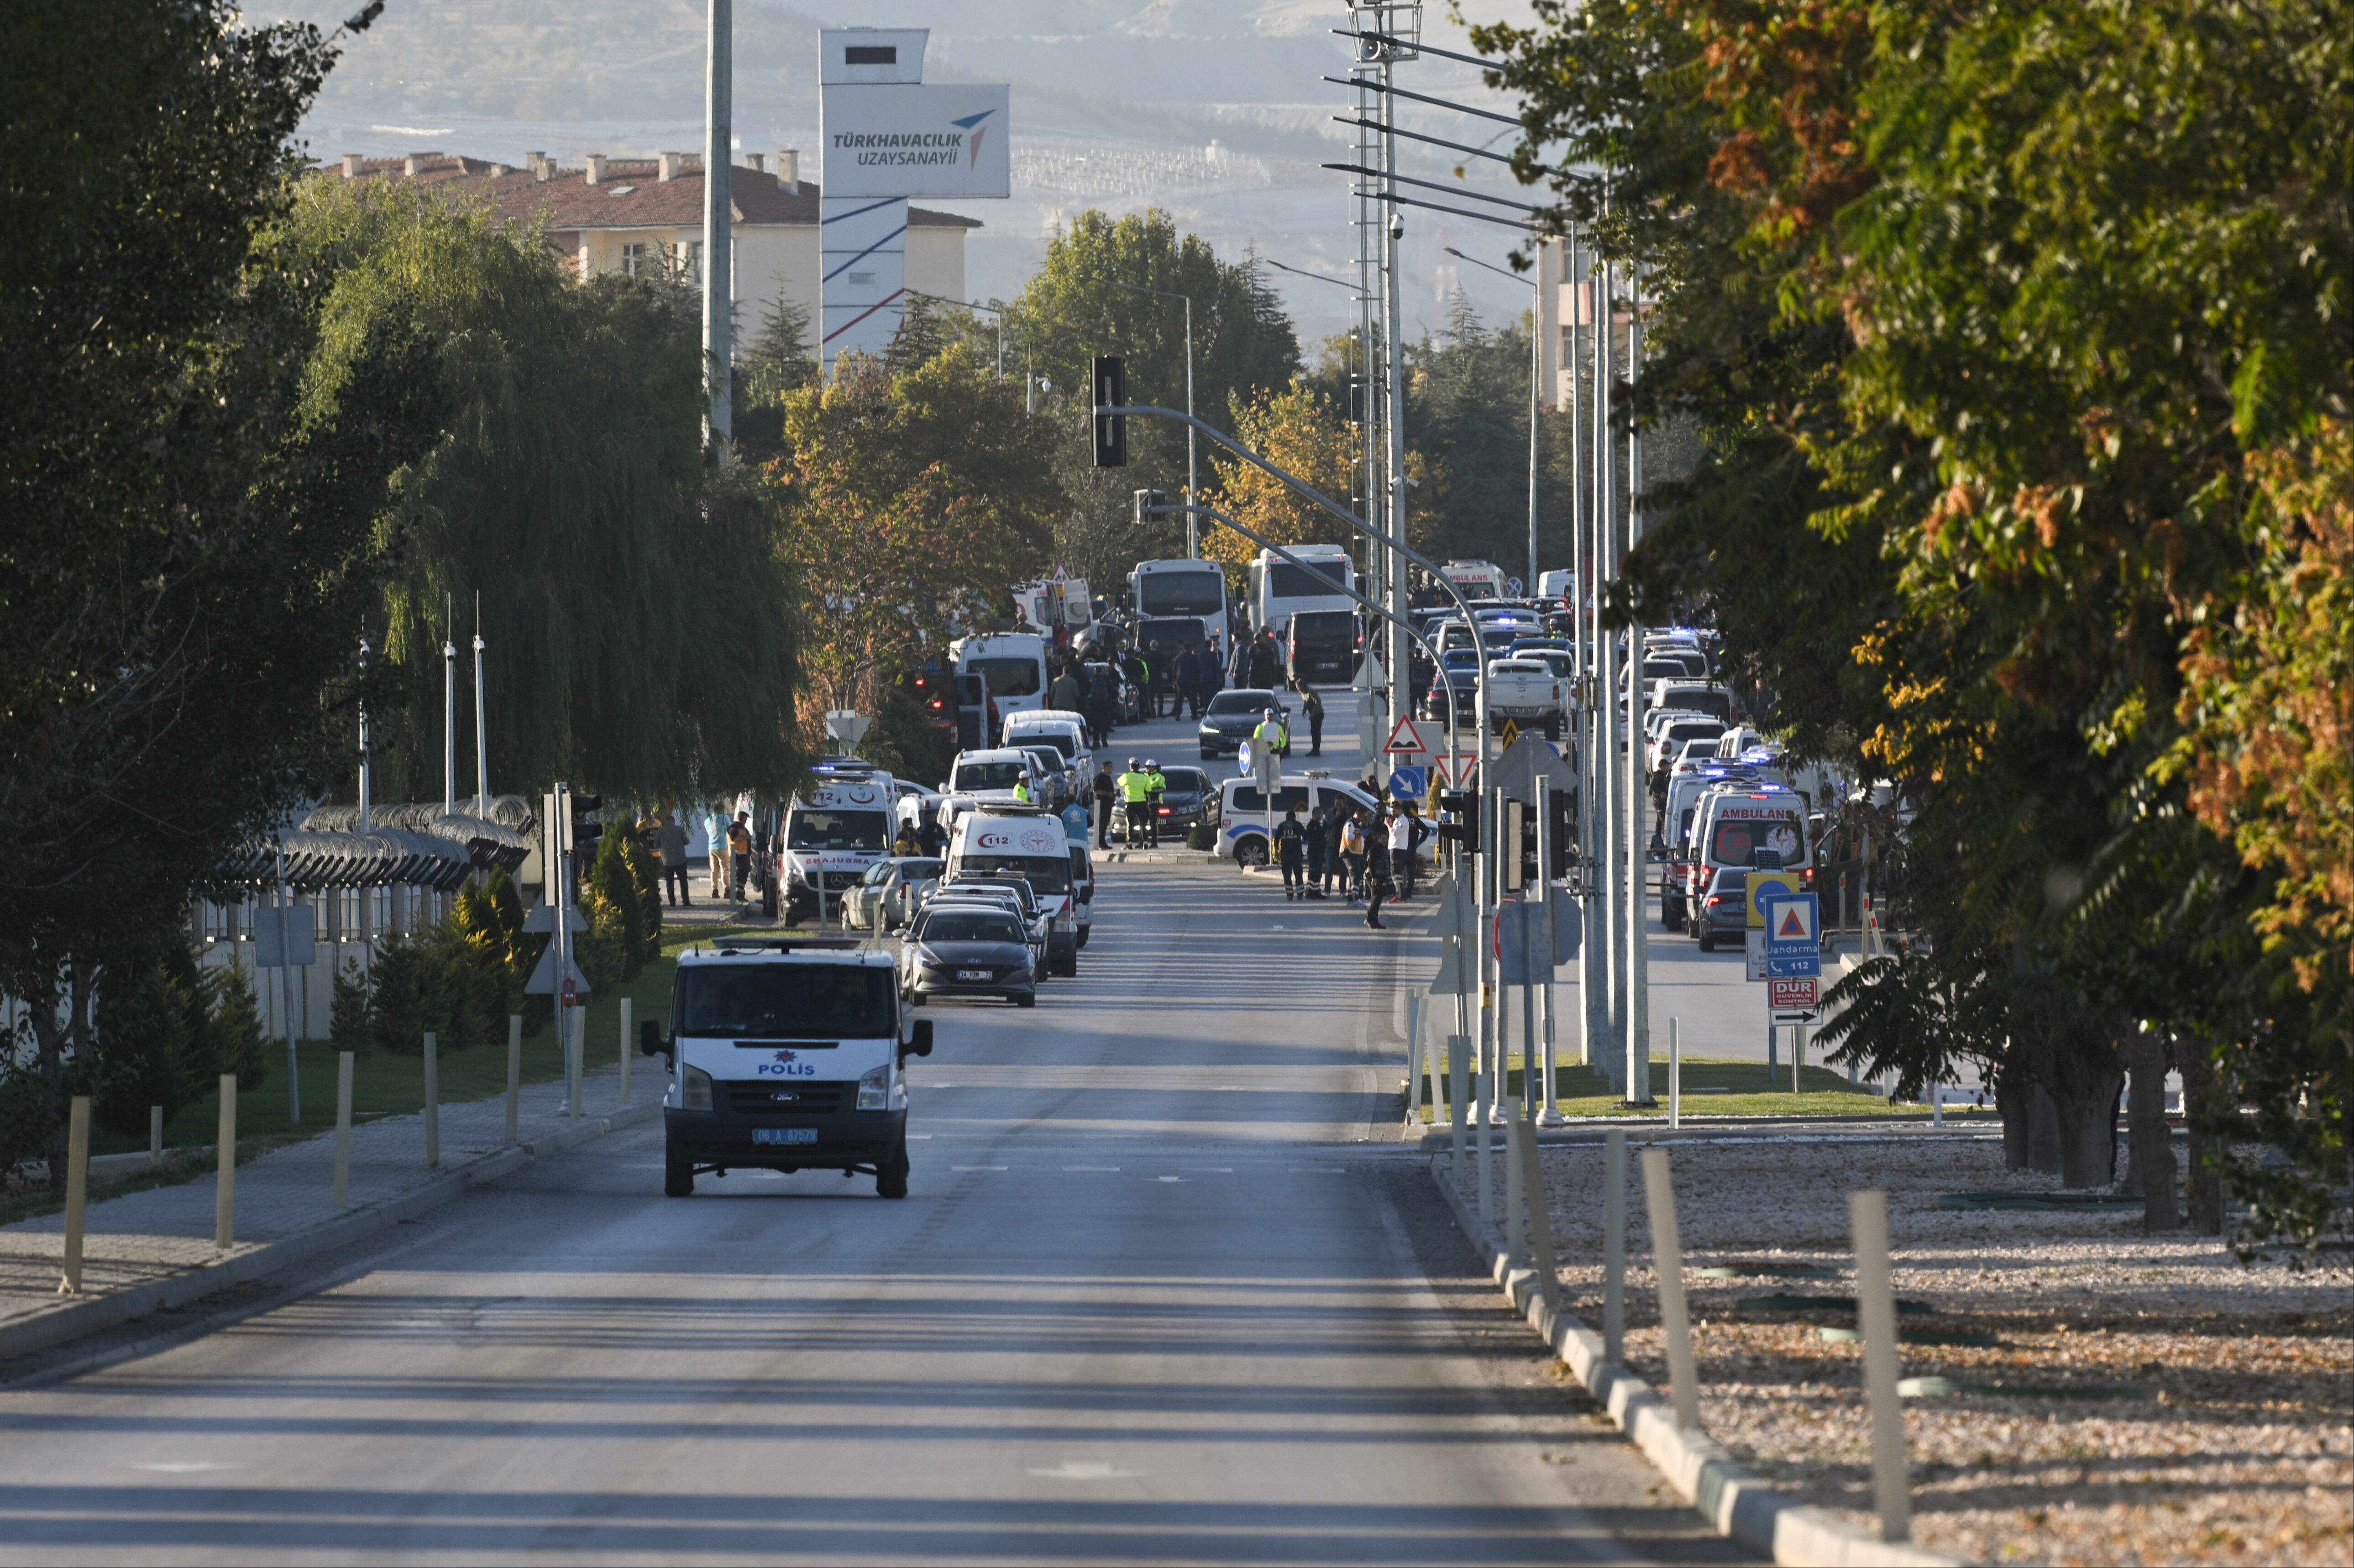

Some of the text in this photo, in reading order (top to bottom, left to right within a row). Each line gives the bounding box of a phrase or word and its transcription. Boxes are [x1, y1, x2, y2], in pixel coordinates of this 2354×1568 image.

[834, 132, 962, 148] TÜRKHAVACILIK
[858, 148, 958, 165] UZAYSANAYİİ
[1768, 945, 1818, 954] Jandarma
[1791, 961, 1809, 970] 112
[1776, 982, 1812, 993] DUR
[758, 1063, 815, 1075] POLİS
[758, 1130, 770, 1140] 06
[776, 1130, 781, 1140] A
